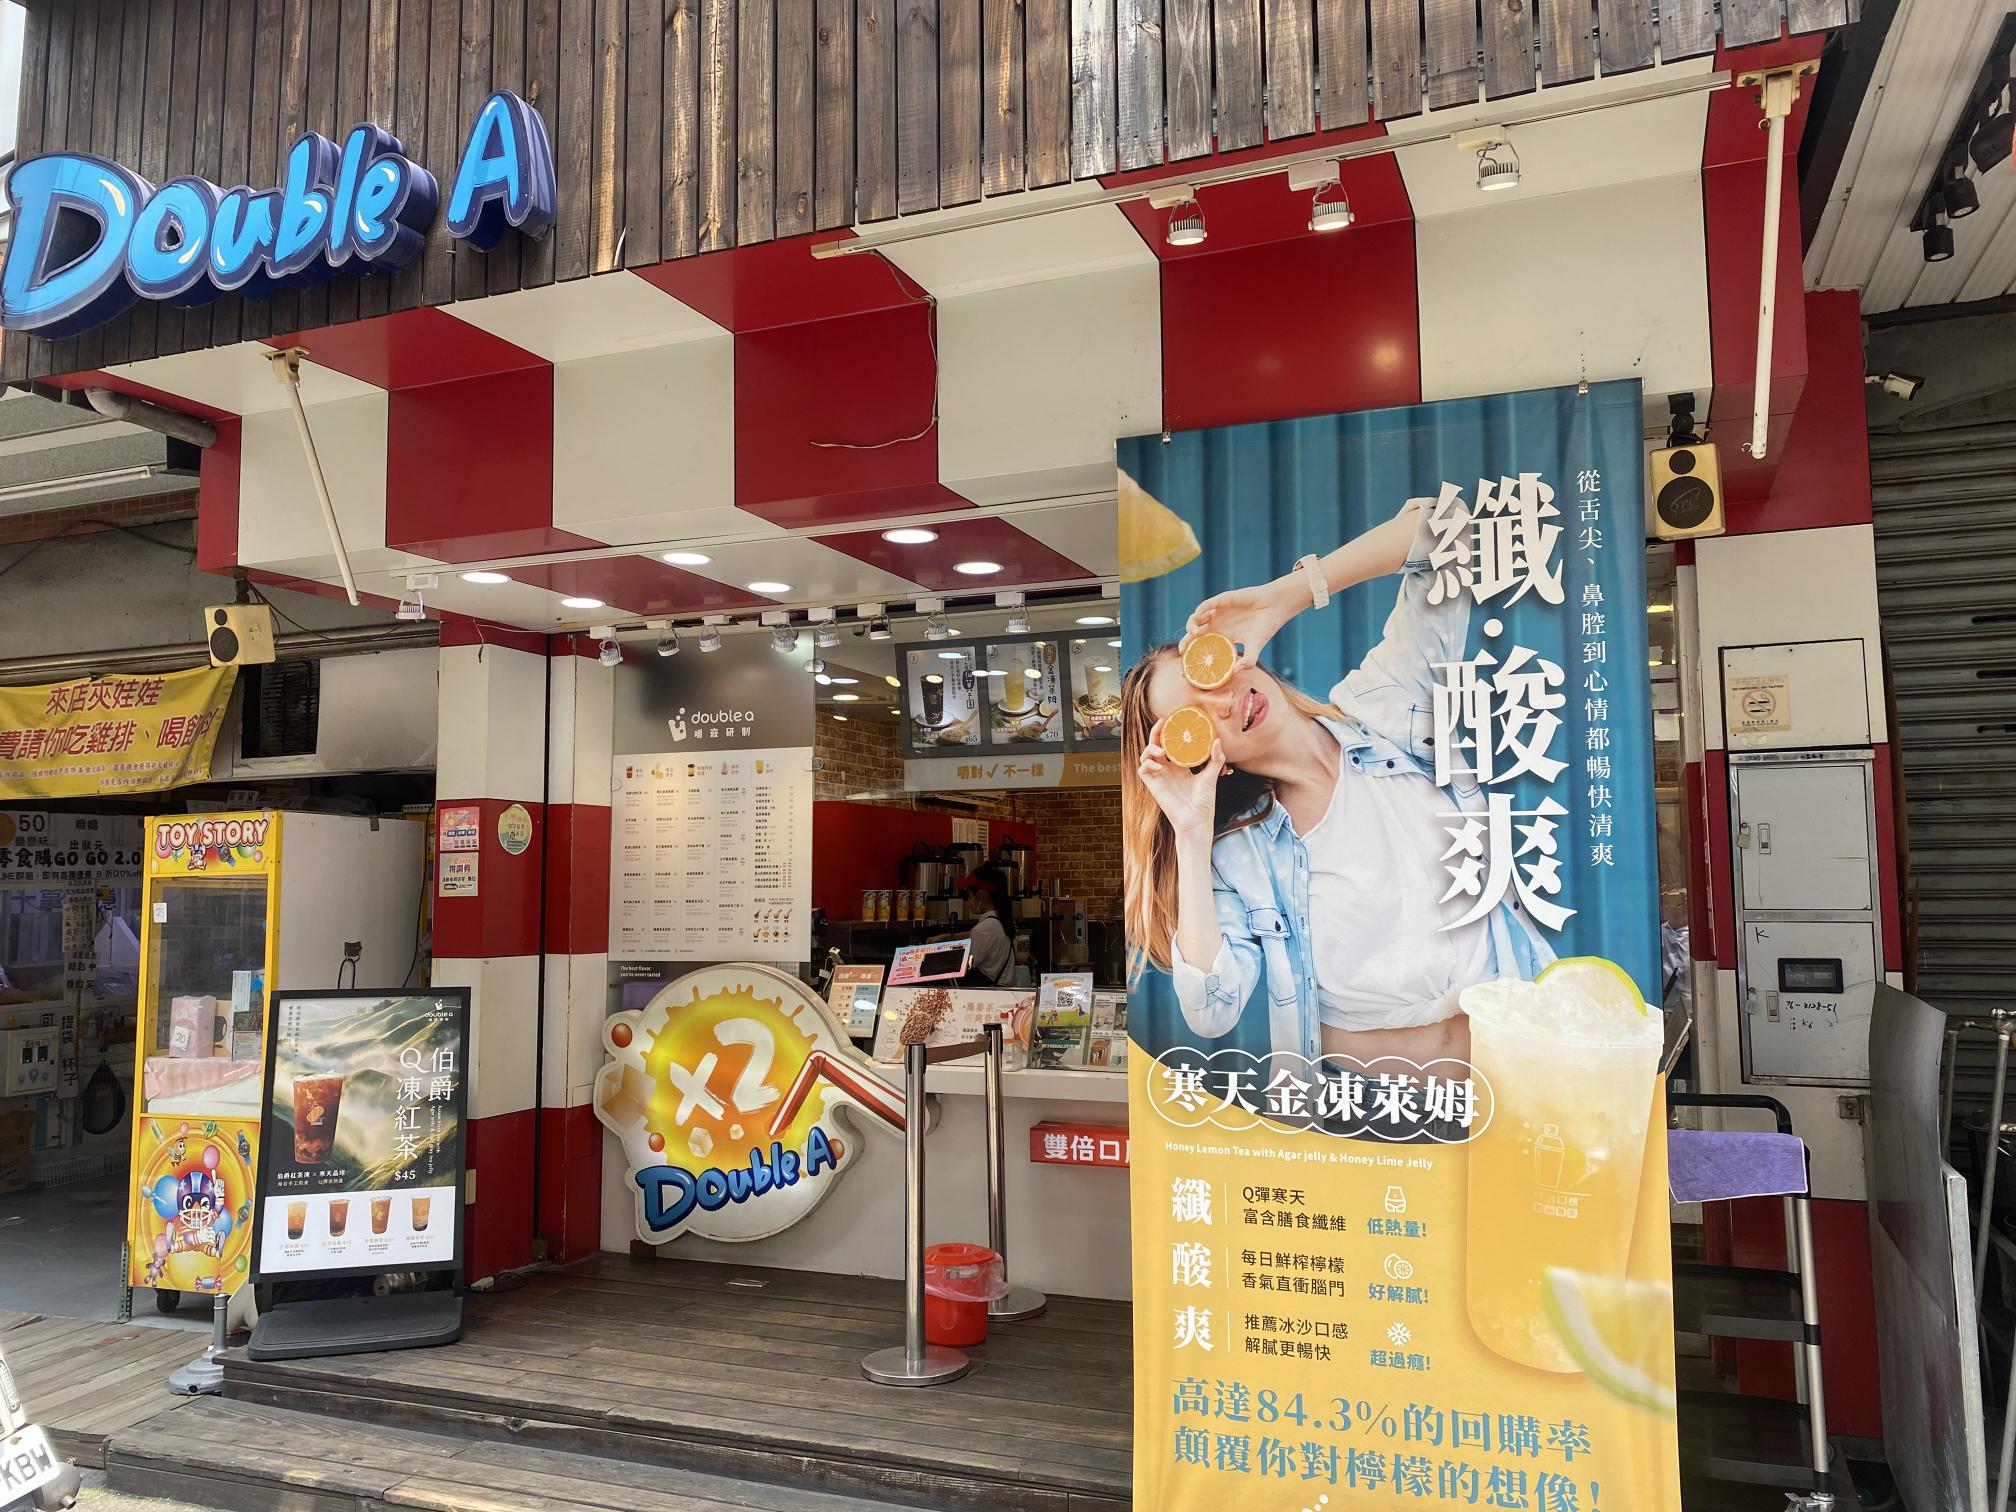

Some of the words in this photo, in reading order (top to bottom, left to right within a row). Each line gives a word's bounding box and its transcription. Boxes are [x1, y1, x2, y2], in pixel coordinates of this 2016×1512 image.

[0, 121, 438, 339] Double
[444, 89, 556, 252] A
[1577, 469, 1614, 867] 從舌尖、鼻腔到心情都暢快清爽
[46, 677, 165, 715] 來店夾娃娃
[691, 709, 742, 724] double
[744, 710, 755, 722] a
[1073, 763, 1095, 774] The
[19, 814, 45, 832] 50
[157, 822, 198, 850] TOY
[201, 819, 269, 849] STORY
[85, 851, 109, 866] GO
[114, 850, 142, 866] 2.0
[428, 1047, 455, 1102] 伯爵
[393, 1047, 429, 1161] Q凍紅茶
[1161, 1063, 1481, 1128] 寒天金凍萊姆
[1043, 1133, 1130, 1163] 雙倍口
[1165, 1141, 1195, 1155] Honey
[1197, 1144, 1230, 1155] Lemon
[1233, 1146, 1250, 1156] Tea
[1252, 1147, 1276, 1158] with
[1278, 1150, 1302, 1161] Agar
[1304, 1150, 1327, 1163] jelly
[1329, 1152, 1337, 1162] &
[1340, 1152, 1374, 1166] Honey
[1377, 1155, 1404, 1166] Lime
[1406, 1157, 1433, 1170] Jelly
[394, 1170, 416, 1182] $45
[635, 1142, 800, 1232] Double
[806, 1126, 838, 1176] A
[1171, 1176, 1214, 1226] 纖
[1242, 1186, 1305, 1206] Q彈寒天
[1243, 1208, 1347, 1232] 富含膳食纖維
[1366, 1217, 1428, 1238] 低熱量!
[1171, 1241, 1214, 1289] 酸
[1241, 1249, 1345, 1275] 每日鮮榨檸檬
[1241, 1273, 1345, 1298] 香氣直衝腦門
[1368, 1283, 1430, 1305] 好解膩!
[1173, 1305, 1216, 1352] 爽
[1244, 1313, 1349, 1341] 推薦冰沙口感
[1245, 1336, 1332, 1362] 解膩更暢快
[1370, 1349, 1432, 1372] 超過癮!
[1171, 1376, 1594, 1464] 高達84.3%的回購率
[1172, 1426, 1602, 1512] 顛覆你對檸檬的想像!
